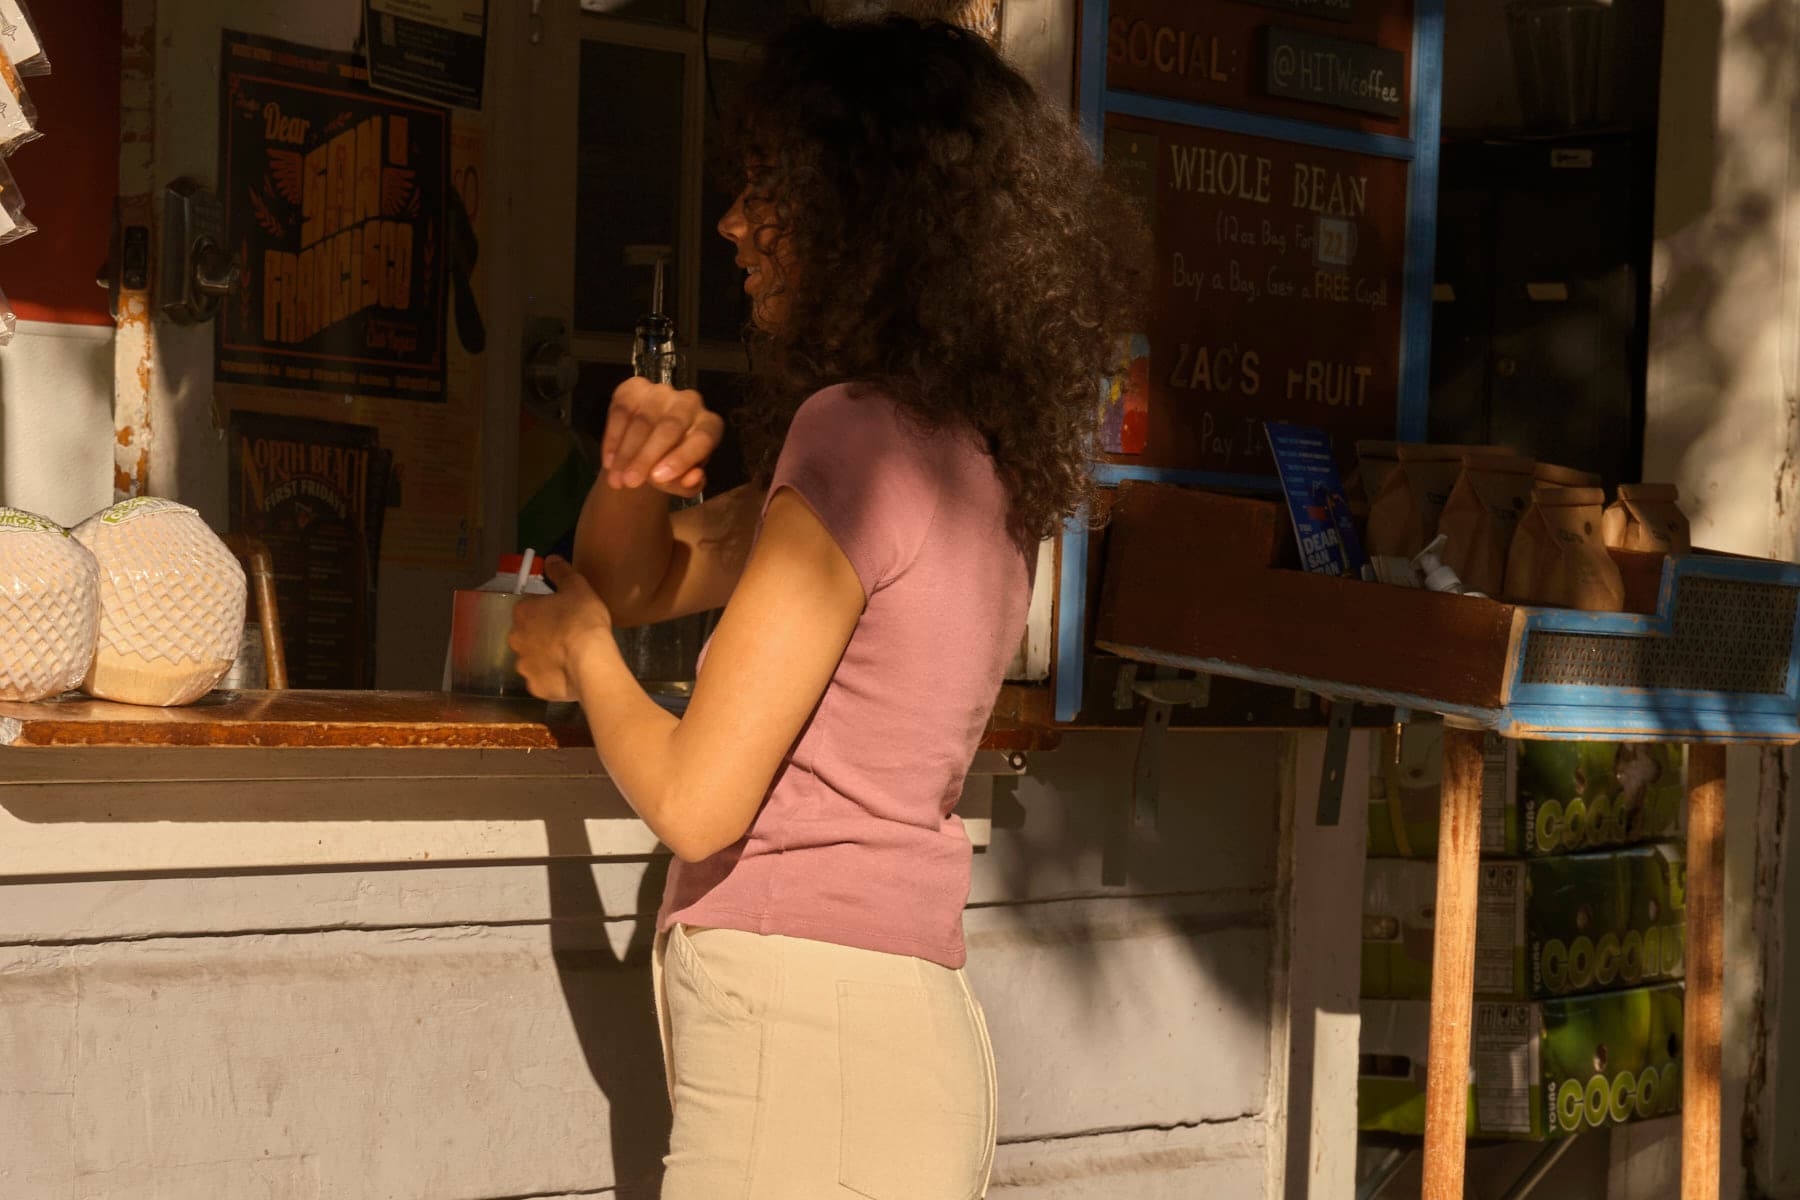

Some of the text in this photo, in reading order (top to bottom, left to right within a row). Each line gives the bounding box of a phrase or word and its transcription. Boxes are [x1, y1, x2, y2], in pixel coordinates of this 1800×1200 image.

[1272, 44, 1400, 103] @HITWcoffee
[263, 102, 311, 145] Dear
[1170, 144, 1368, 217] WHOLE BEAN
[1172, 251, 1205, 302] Buy
[1212, 274, 1224, 290] a
[1267, 266, 1296, 297] Get
[1315, 271, 1350, 303] FREE
[1169, 342, 1262, 397] ZAC'S
[1200, 410, 1233, 464] Pay
[241, 436, 305, 512] NORTH
[310, 443, 370, 513] BEACH
[265, 479, 298, 512] FIRST
[1302, 528, 1338, 555] DEAR
